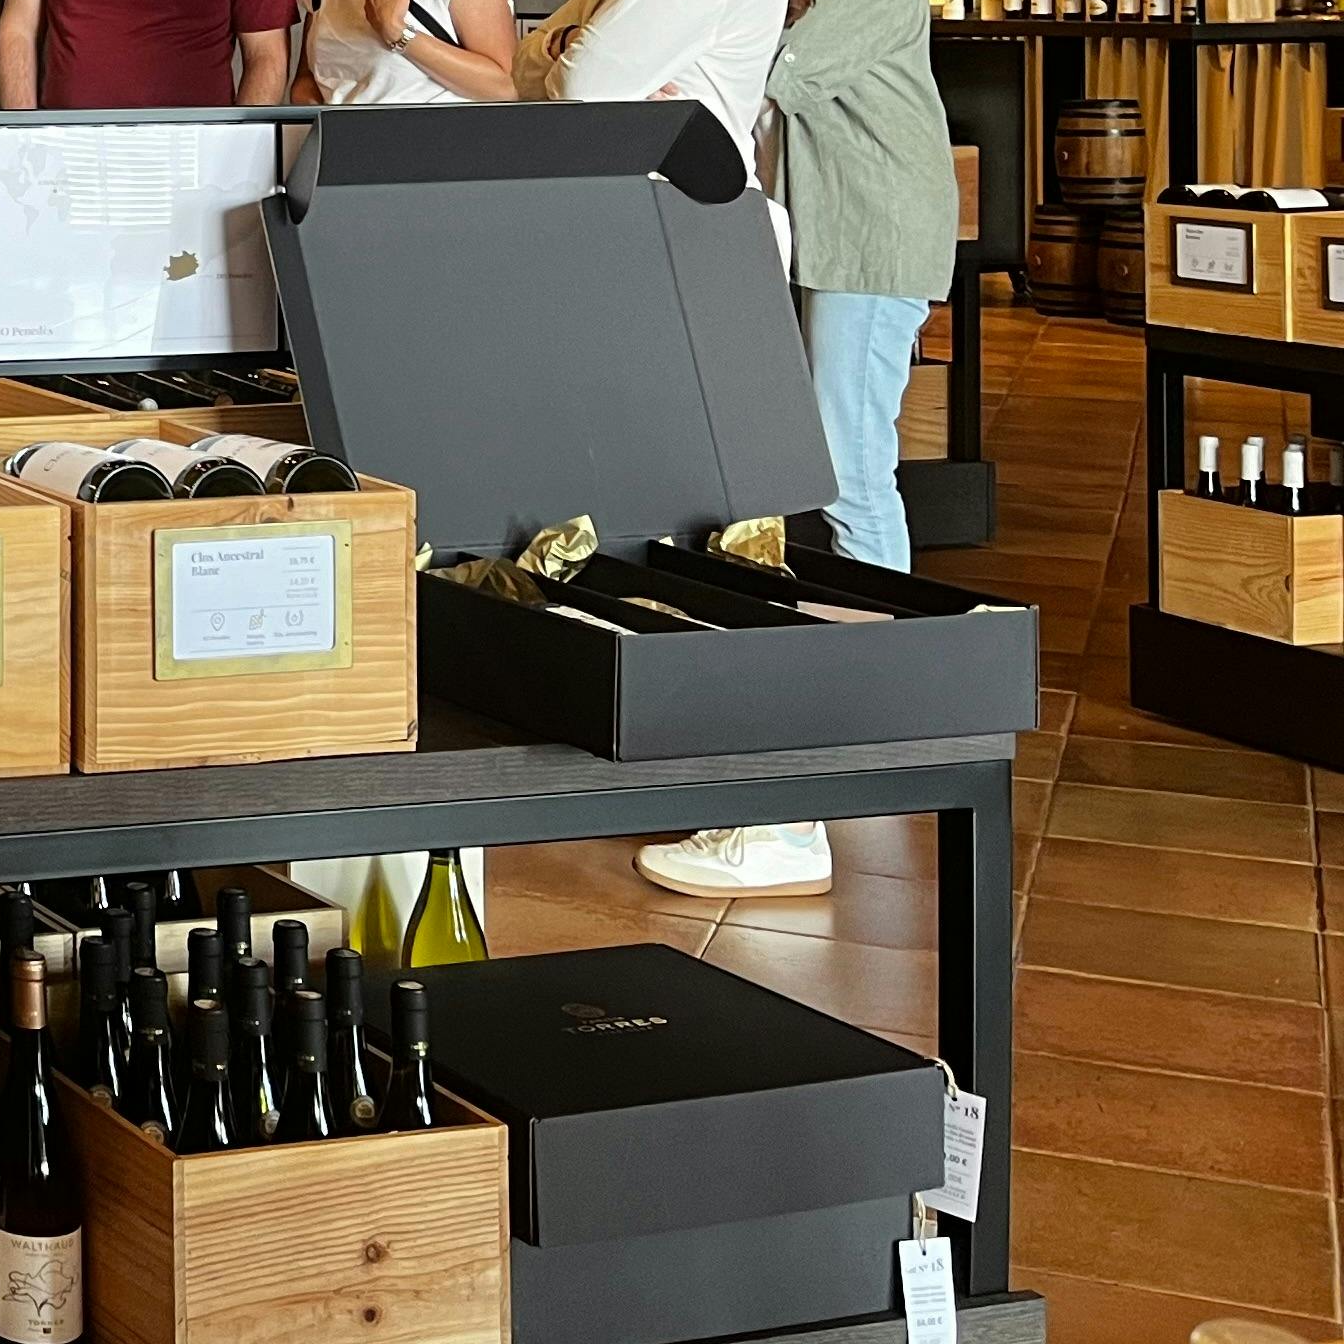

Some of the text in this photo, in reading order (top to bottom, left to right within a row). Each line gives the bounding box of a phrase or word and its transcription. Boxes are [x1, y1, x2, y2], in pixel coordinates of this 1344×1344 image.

[217, 550, 265, 562] Ancestral
[964, 1106, 979, 1119] 18
[11, 1238, 74, 1252] WALTRAUD
[932, 1257, 944, 1272] 18
